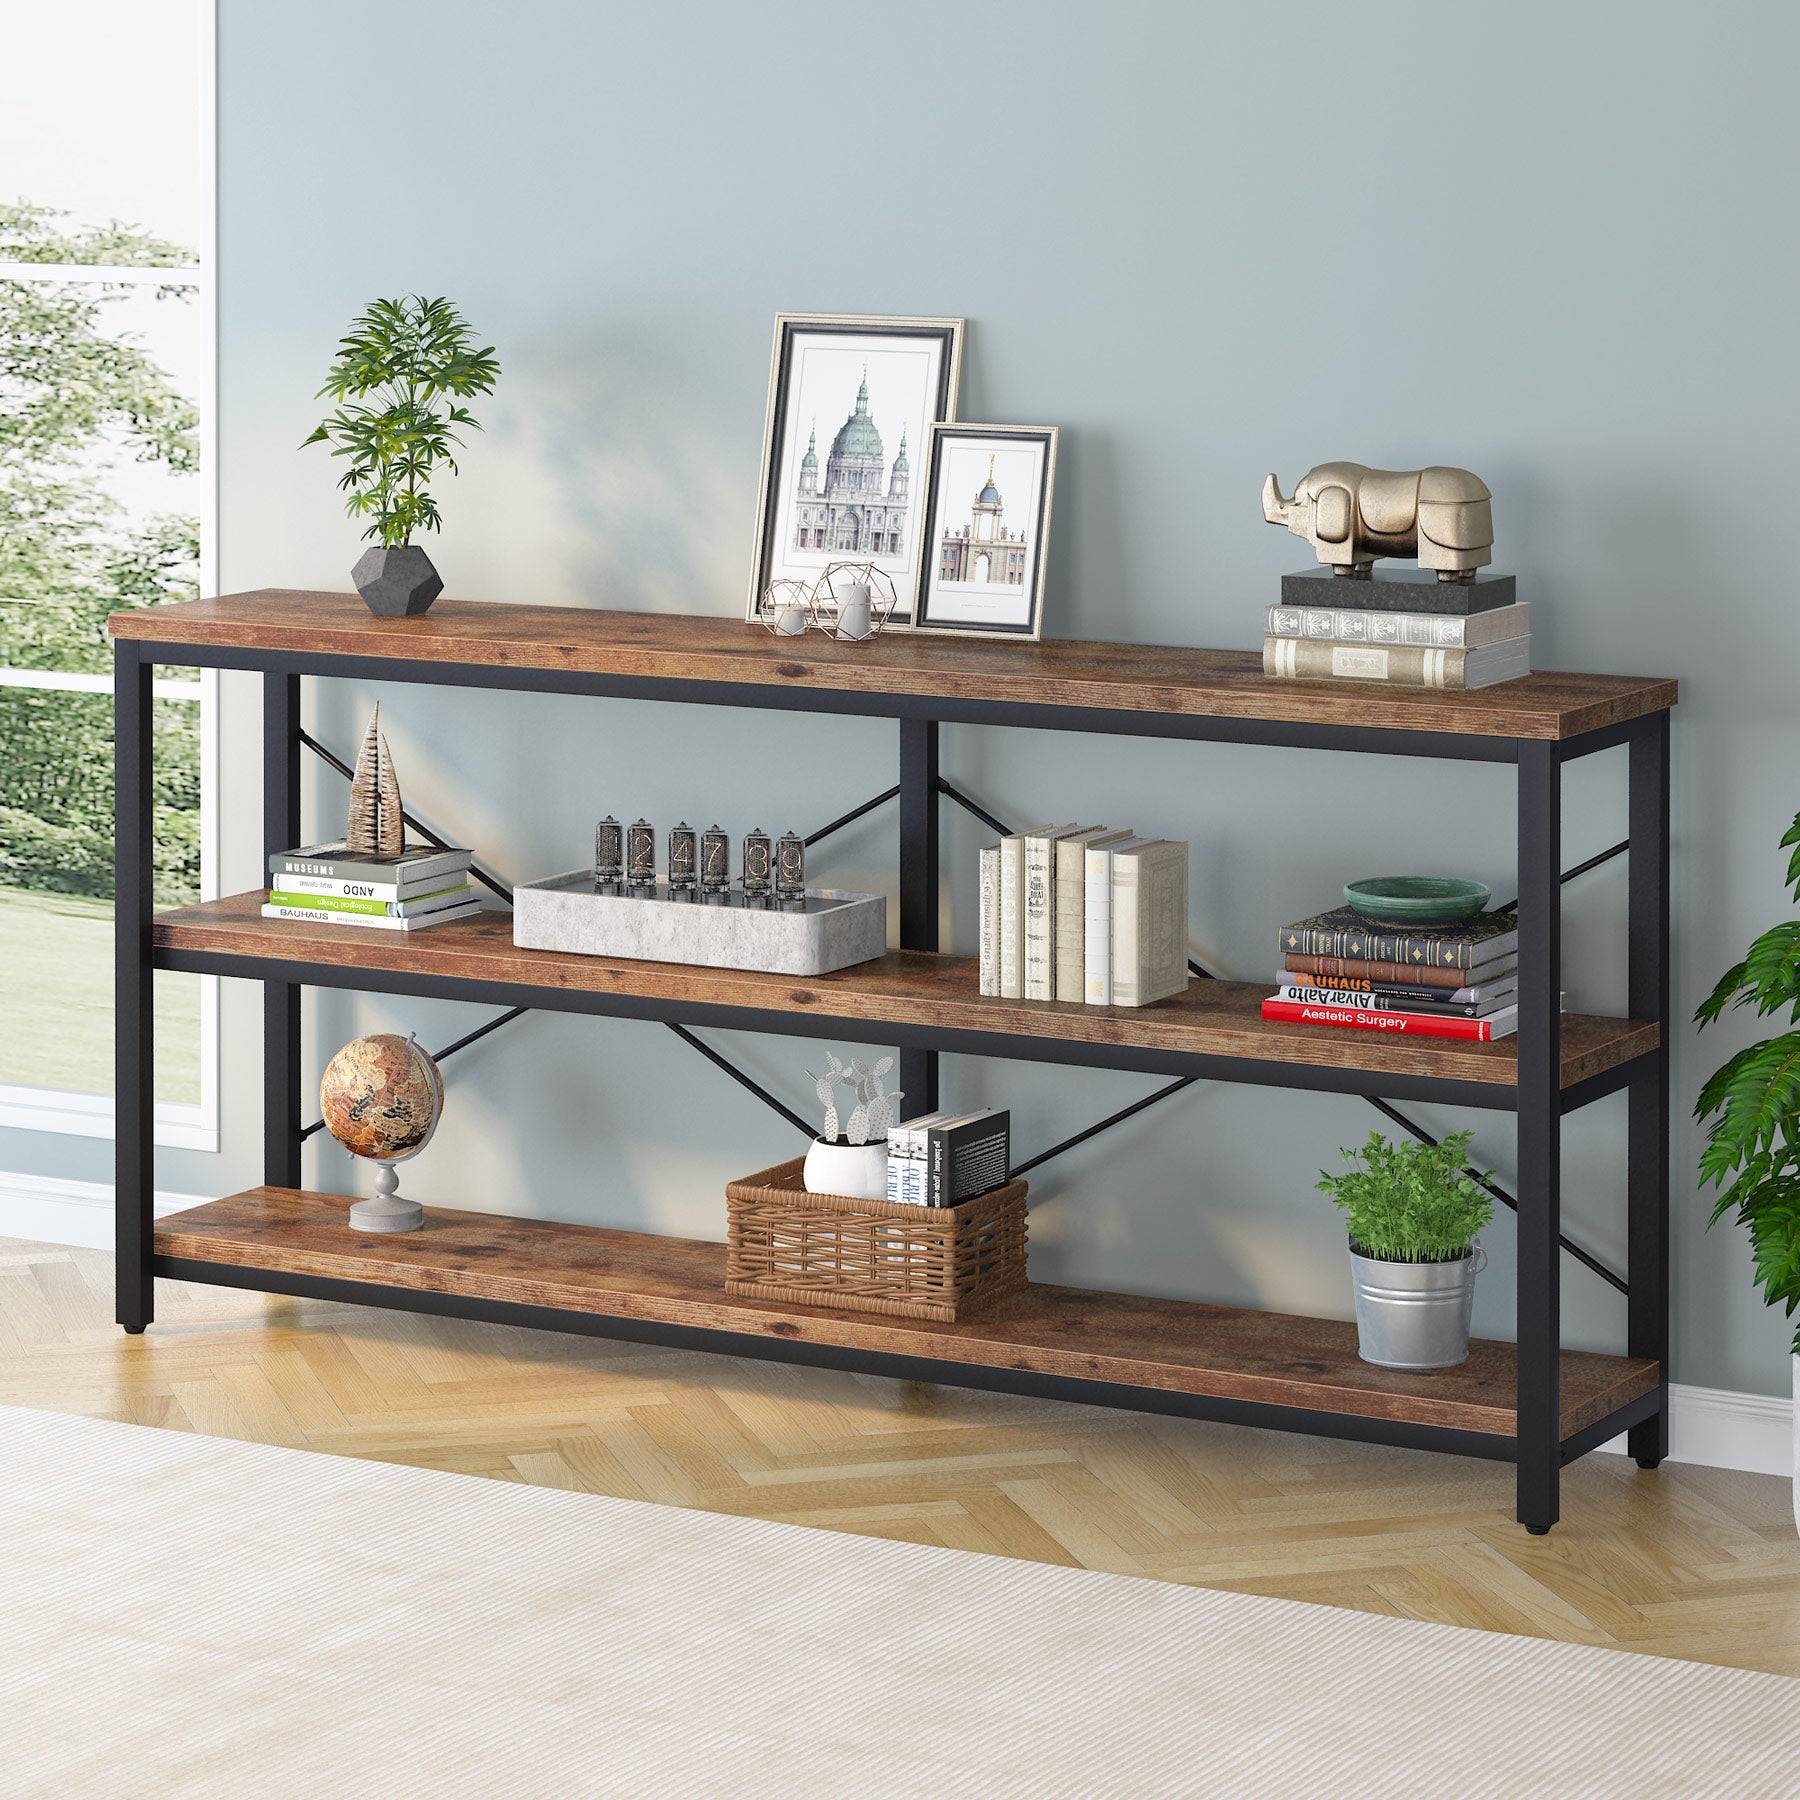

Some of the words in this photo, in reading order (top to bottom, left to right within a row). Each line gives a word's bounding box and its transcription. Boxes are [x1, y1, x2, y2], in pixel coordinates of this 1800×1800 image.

[285, 862, 334, 876] MUSEUMS
[343, 884, 375, 897] ANDO
[317, 898, 339, 909] Design
[340, 901, 373, 912] Ecological
[279, 908, 329, 920] BAUHAUS
[1295, 973, 1371, 992] BAUHAUS
[1302, 1008, 1353, 1023] Aestetic
[1356, 1013, 1407, 1030] Surgery
